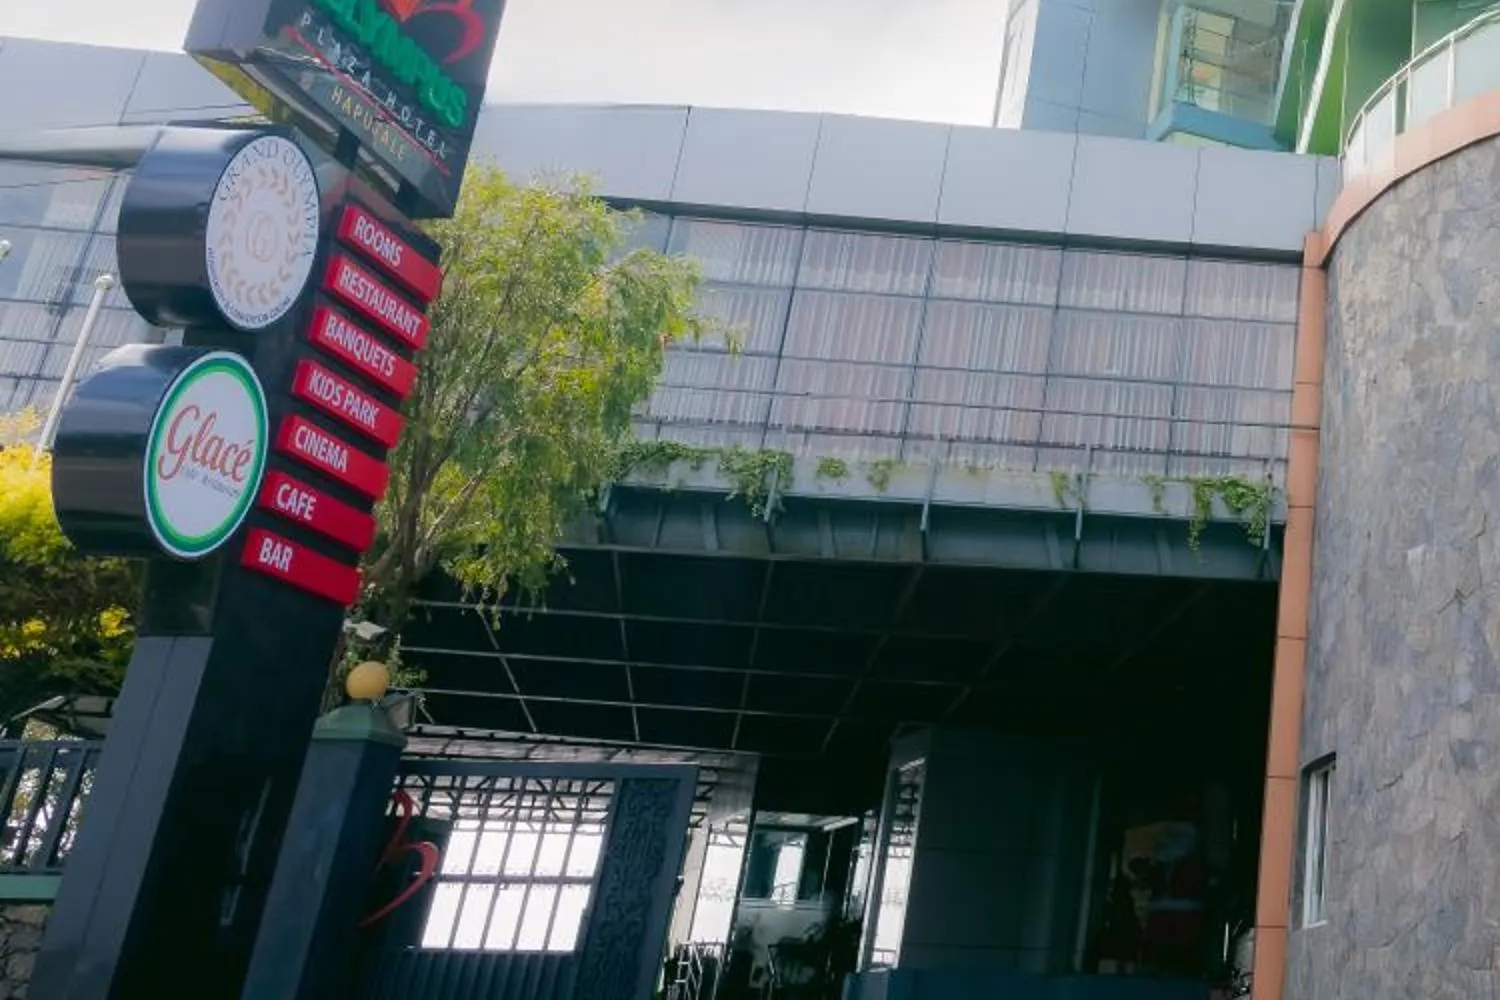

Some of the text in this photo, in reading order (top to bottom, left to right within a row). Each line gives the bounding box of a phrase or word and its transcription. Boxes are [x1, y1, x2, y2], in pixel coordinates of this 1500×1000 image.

[384, 90, 446, 159] HOTEL
[354, 215, 403, 268] ROOMS
[339, 265, 422, 338] RESTAURANT
[324, 314, 396, 378] BANQUETS
[309, 370, 379, 429] KIDS PARK
[158, 404, 255, 482] Glacé
[295, 425, 349, 473] CINEMA
[275, 483, 317, 521] CAFE
[257, 537, 293, 573] BAR
